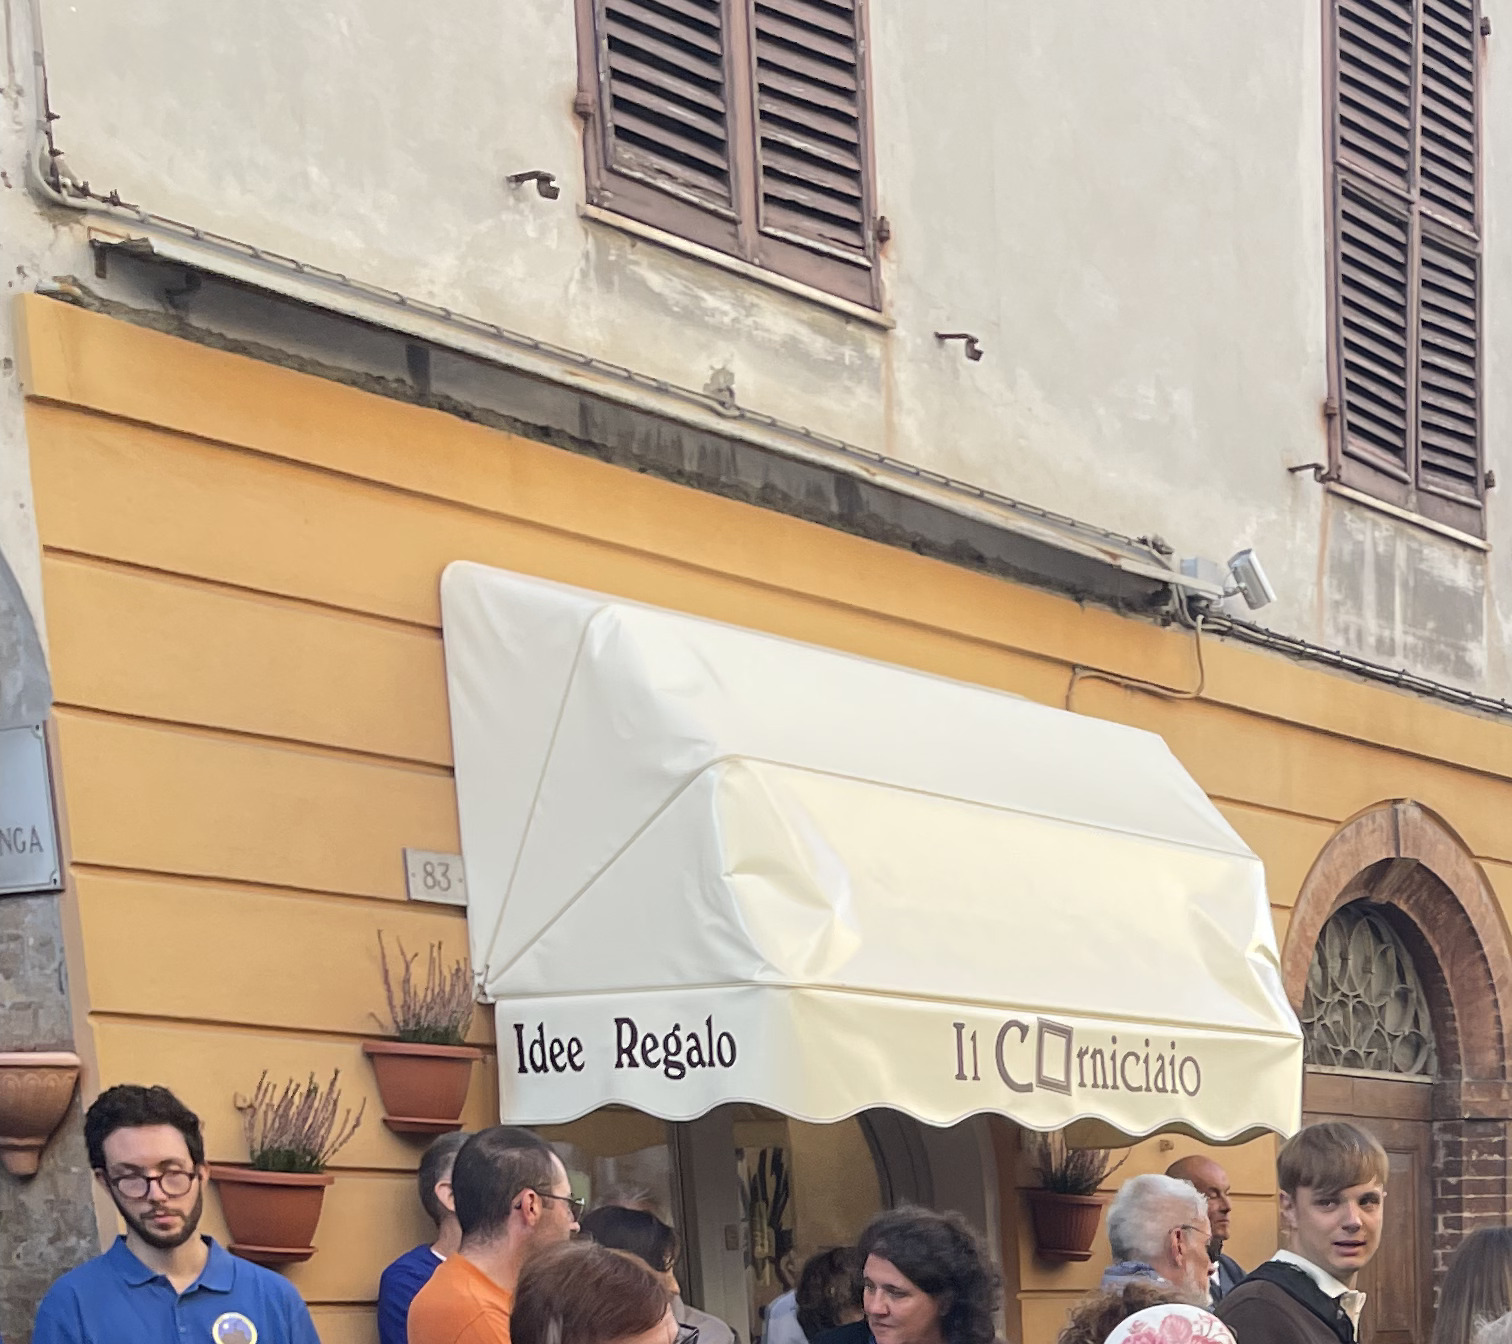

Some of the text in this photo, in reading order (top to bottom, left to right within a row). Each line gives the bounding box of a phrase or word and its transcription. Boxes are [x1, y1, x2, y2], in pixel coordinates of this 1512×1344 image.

[423, 861, 451, 891] 83
[513, 1014, 737, 1080] Idee Regalo
